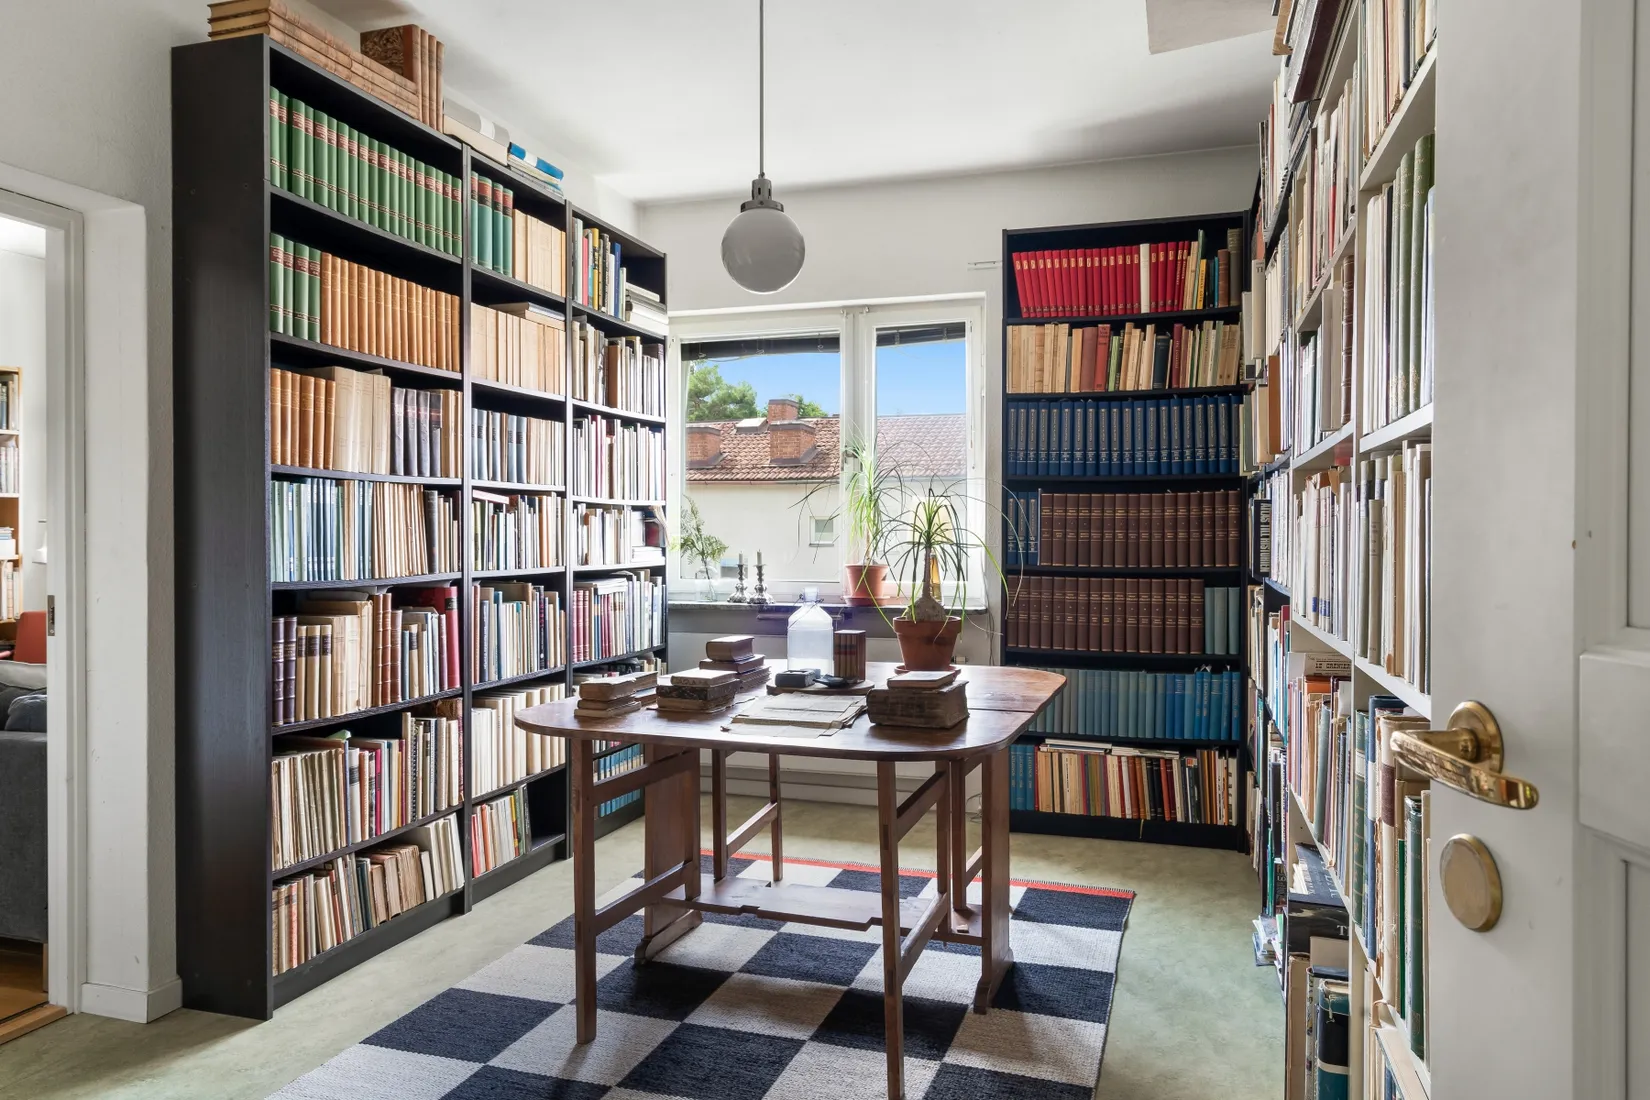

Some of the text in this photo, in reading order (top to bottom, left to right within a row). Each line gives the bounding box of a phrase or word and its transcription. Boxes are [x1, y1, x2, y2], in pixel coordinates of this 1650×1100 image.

[1260, 503, 1271, 573] ATLAS TILL HISTORIEN
